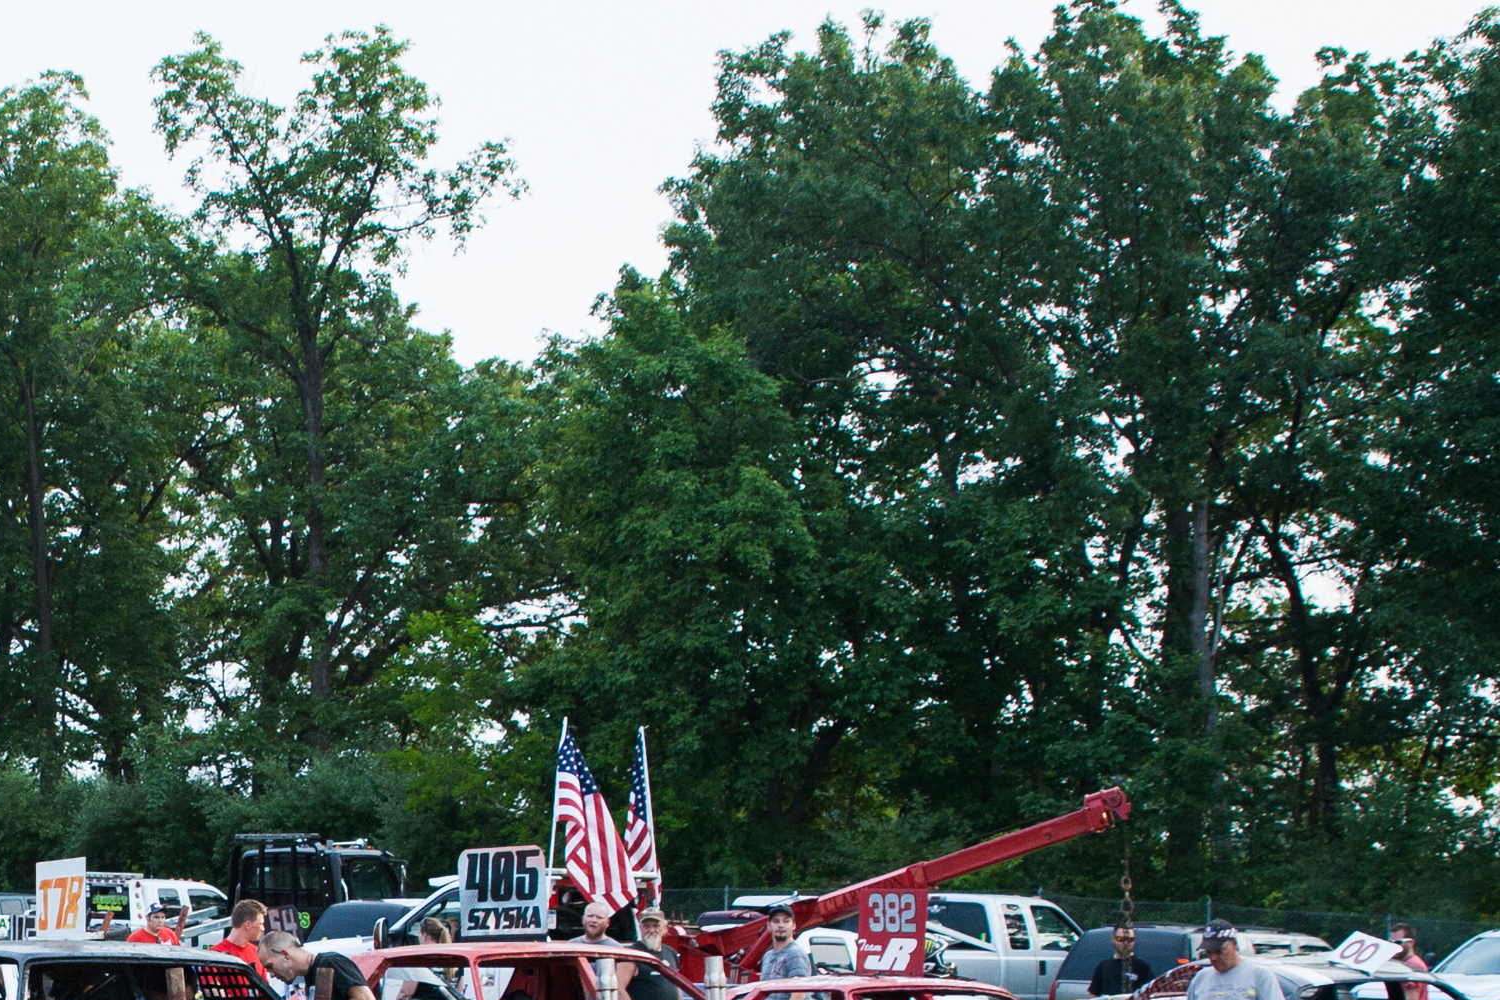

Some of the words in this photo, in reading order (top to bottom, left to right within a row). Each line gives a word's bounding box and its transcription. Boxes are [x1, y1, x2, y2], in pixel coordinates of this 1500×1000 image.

[465, 849, 540, 902] 405
[467, 905, 541, 930] SZYSKA
[868, 893, 917, 933] 382
[863, 937, 918, 971] JR
